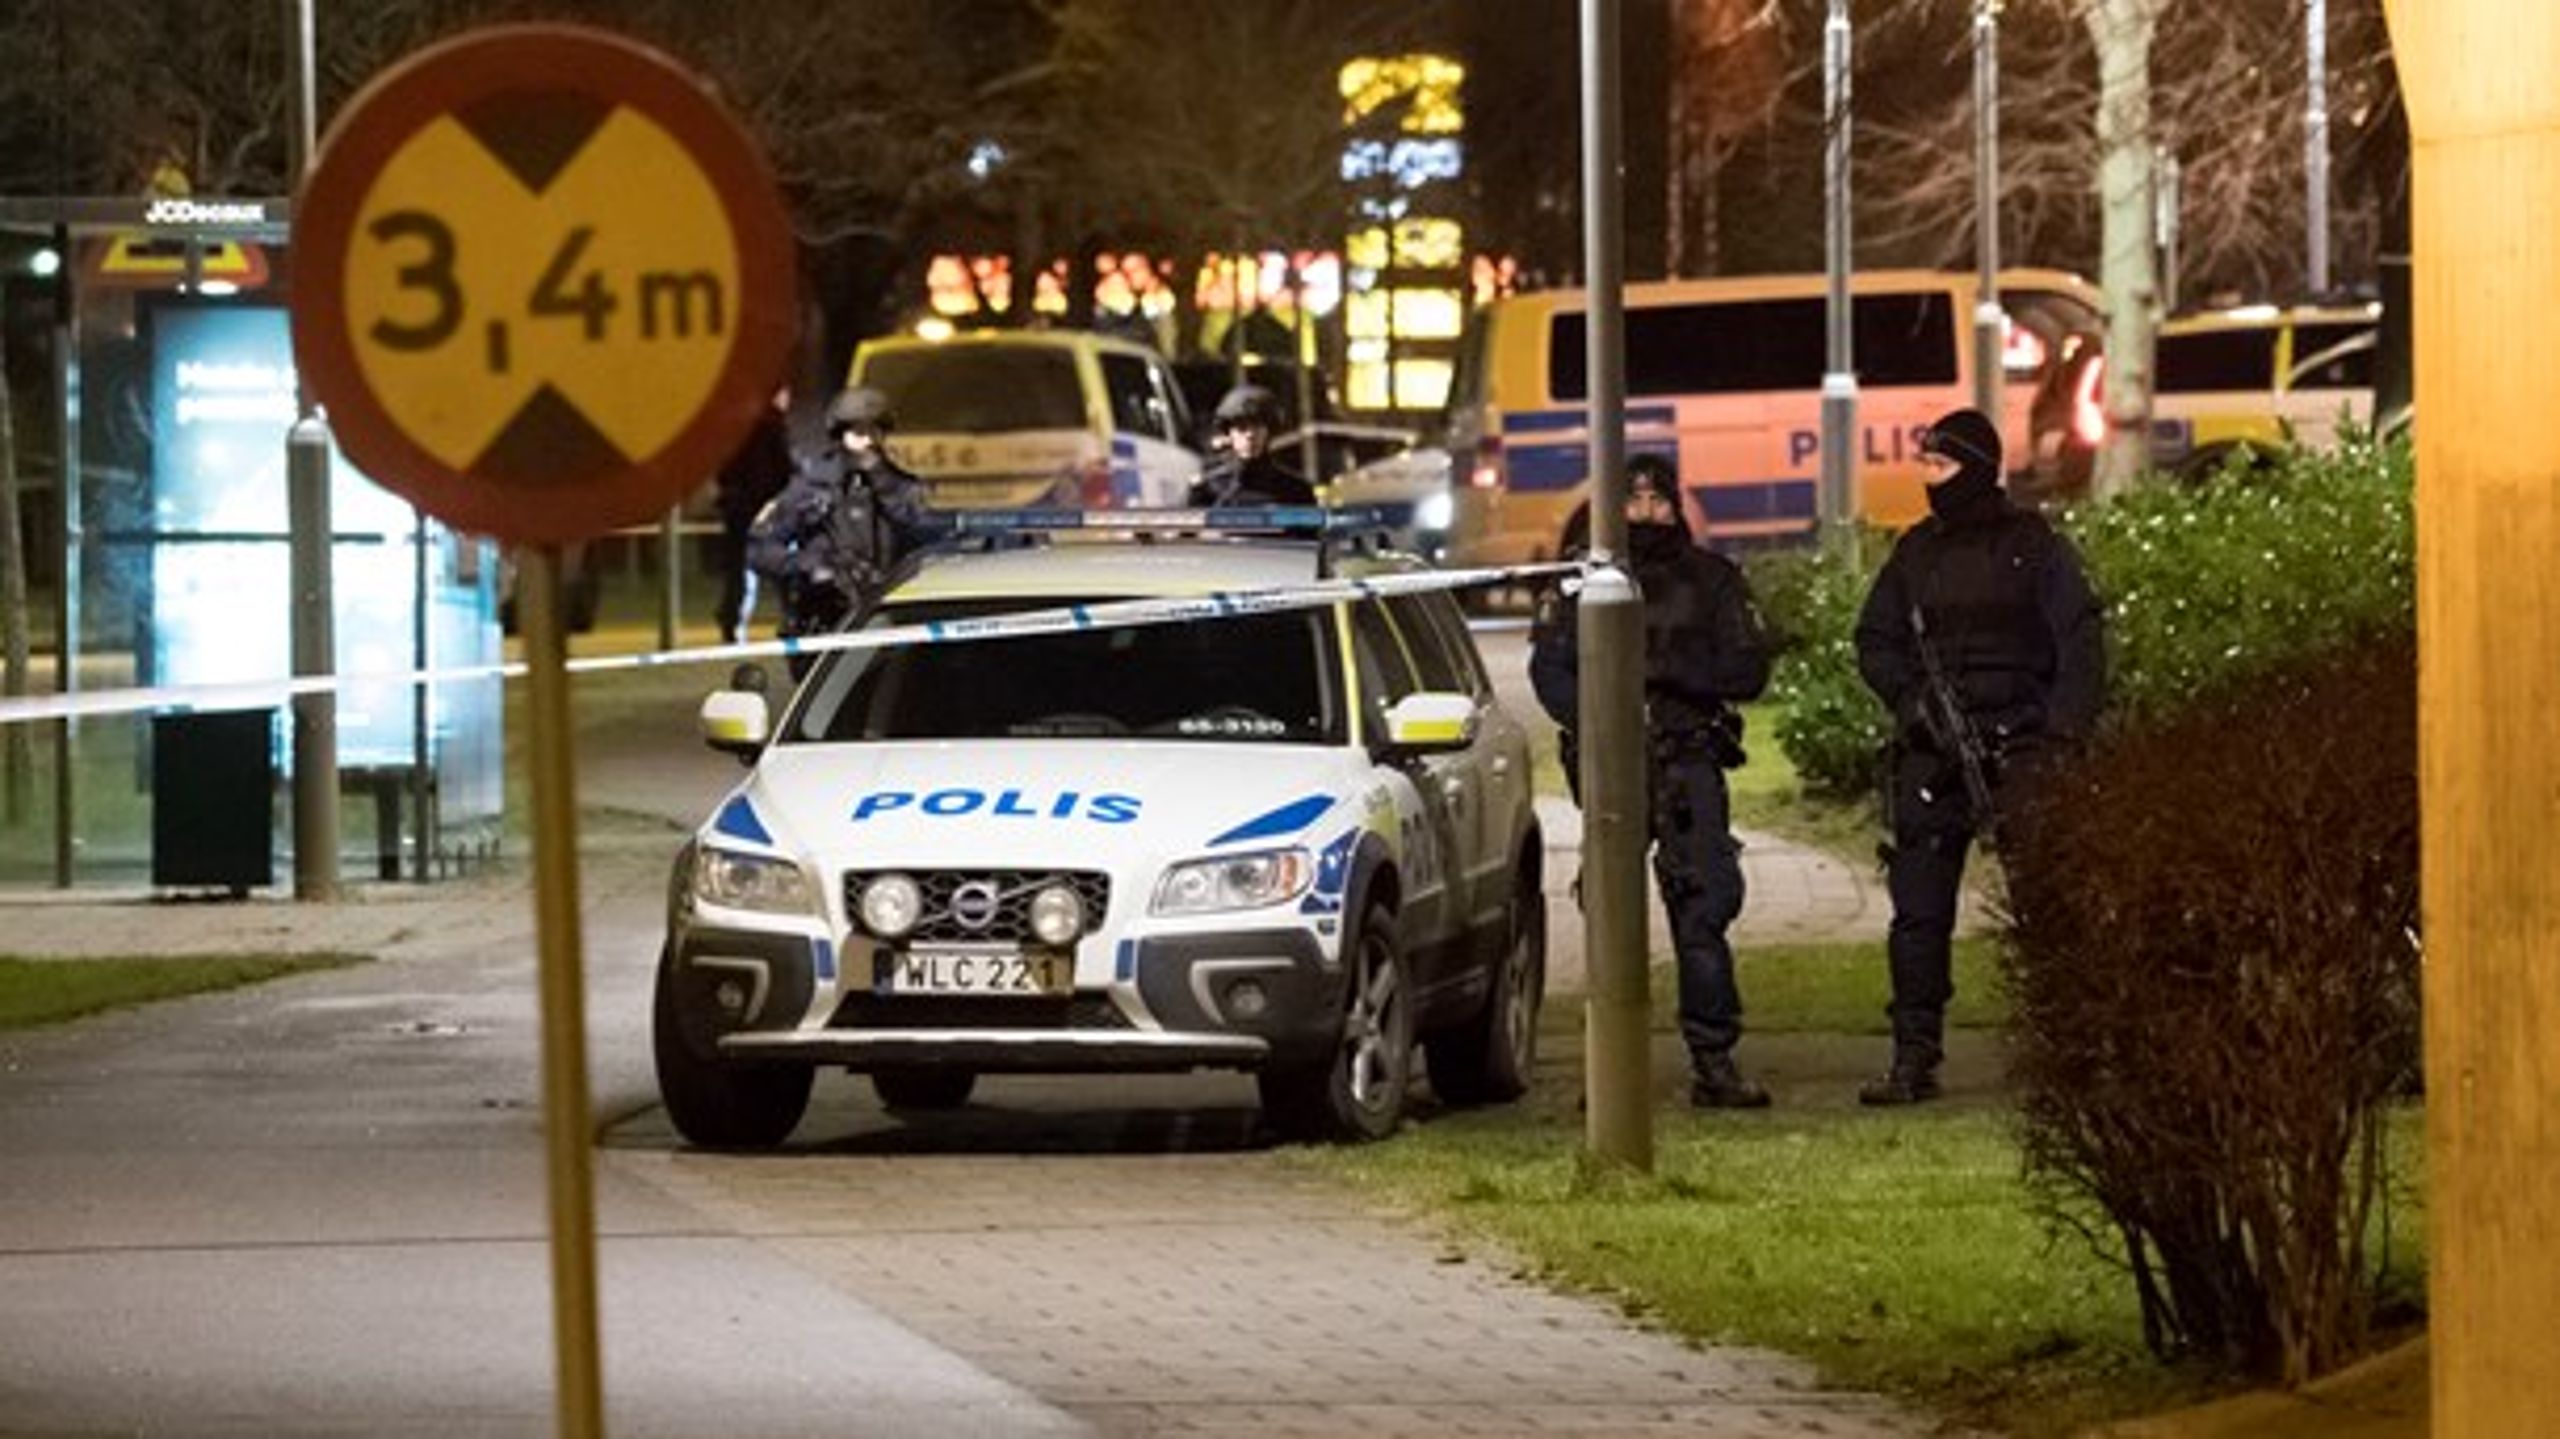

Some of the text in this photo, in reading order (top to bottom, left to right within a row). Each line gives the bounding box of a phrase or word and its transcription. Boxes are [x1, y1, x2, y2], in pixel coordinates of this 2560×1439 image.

[369, 210, 724, 374] 3,4 m
[1790, 424, 1936, 468] PLIS
[852, 788, 1143, 823] POLIS
[906, 957, 1055, 988] WLC 221
